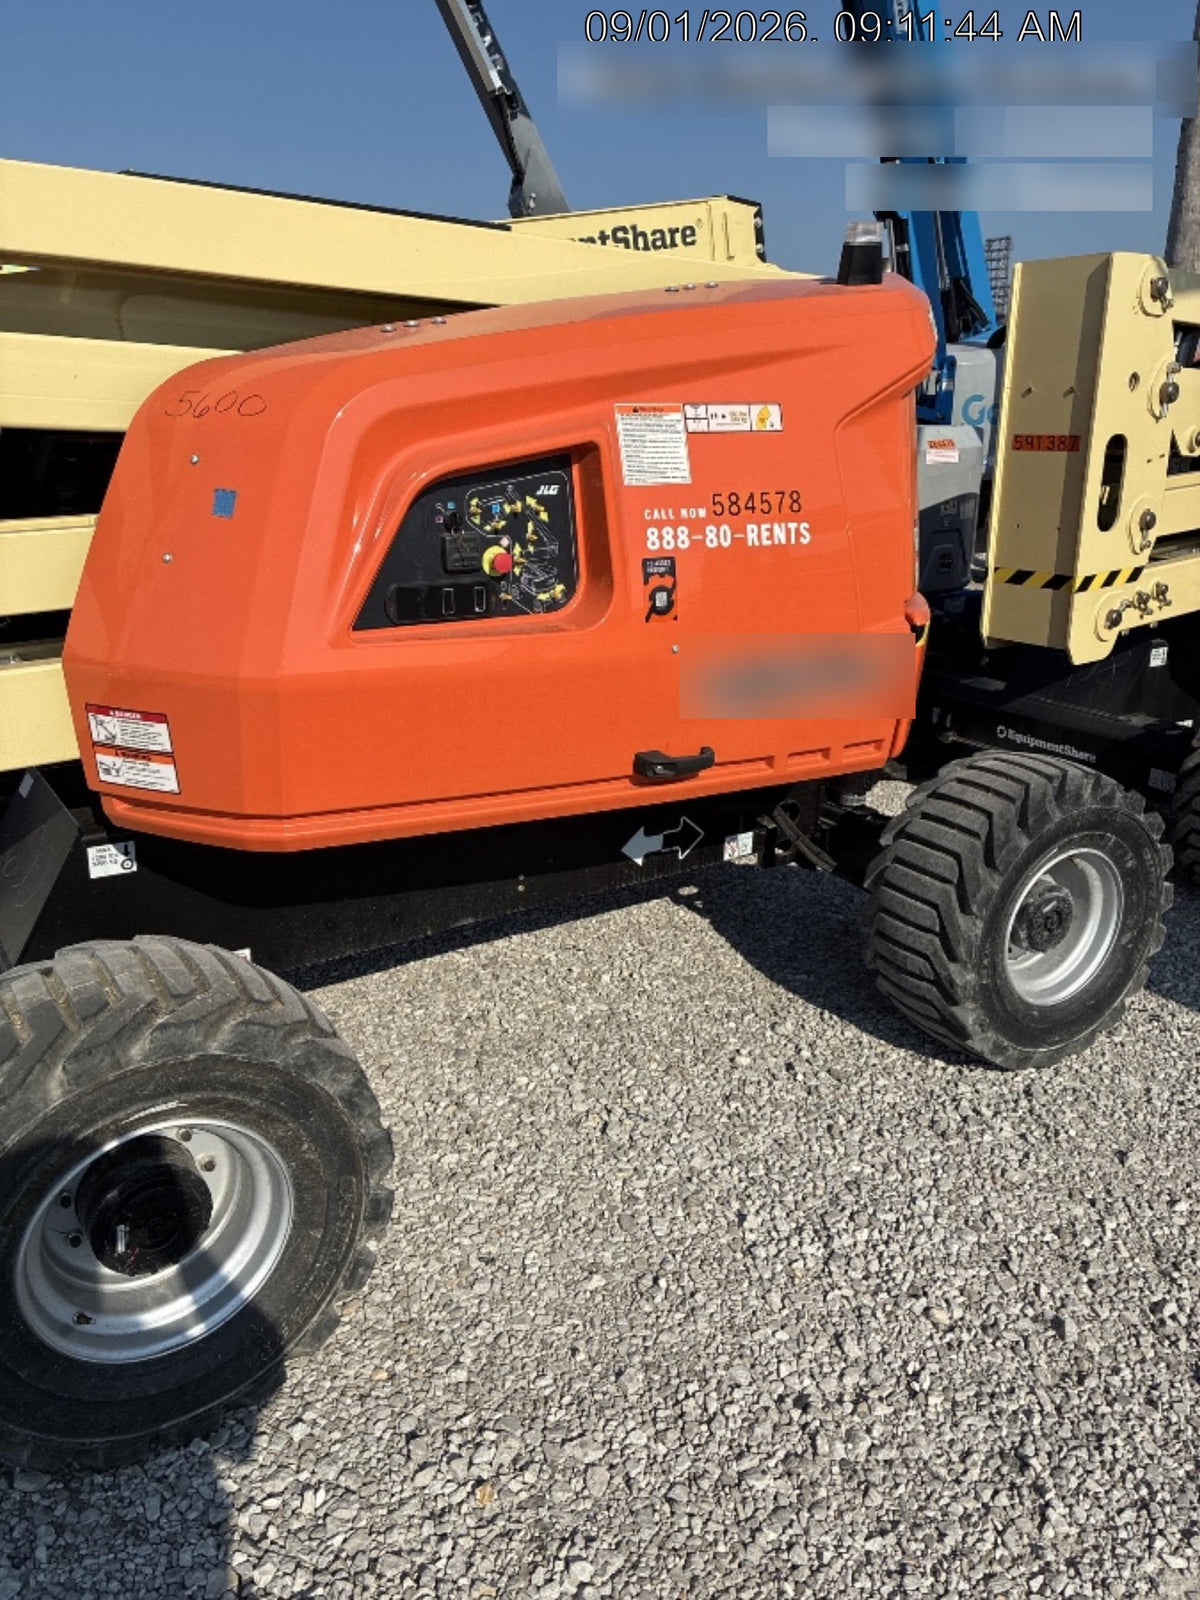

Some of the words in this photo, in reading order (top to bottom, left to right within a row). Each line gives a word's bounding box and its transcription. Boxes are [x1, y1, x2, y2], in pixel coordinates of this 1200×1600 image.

[165, 389, 268, 418] 5600
[536, 484, 561, 495] JLG
[644, 508, 675, 521] CALL
[680, 507, 707, 520] NOW
[711, 490, 803, 516] 584578
[646, 522, 812, 550] 888-80-RENTS
